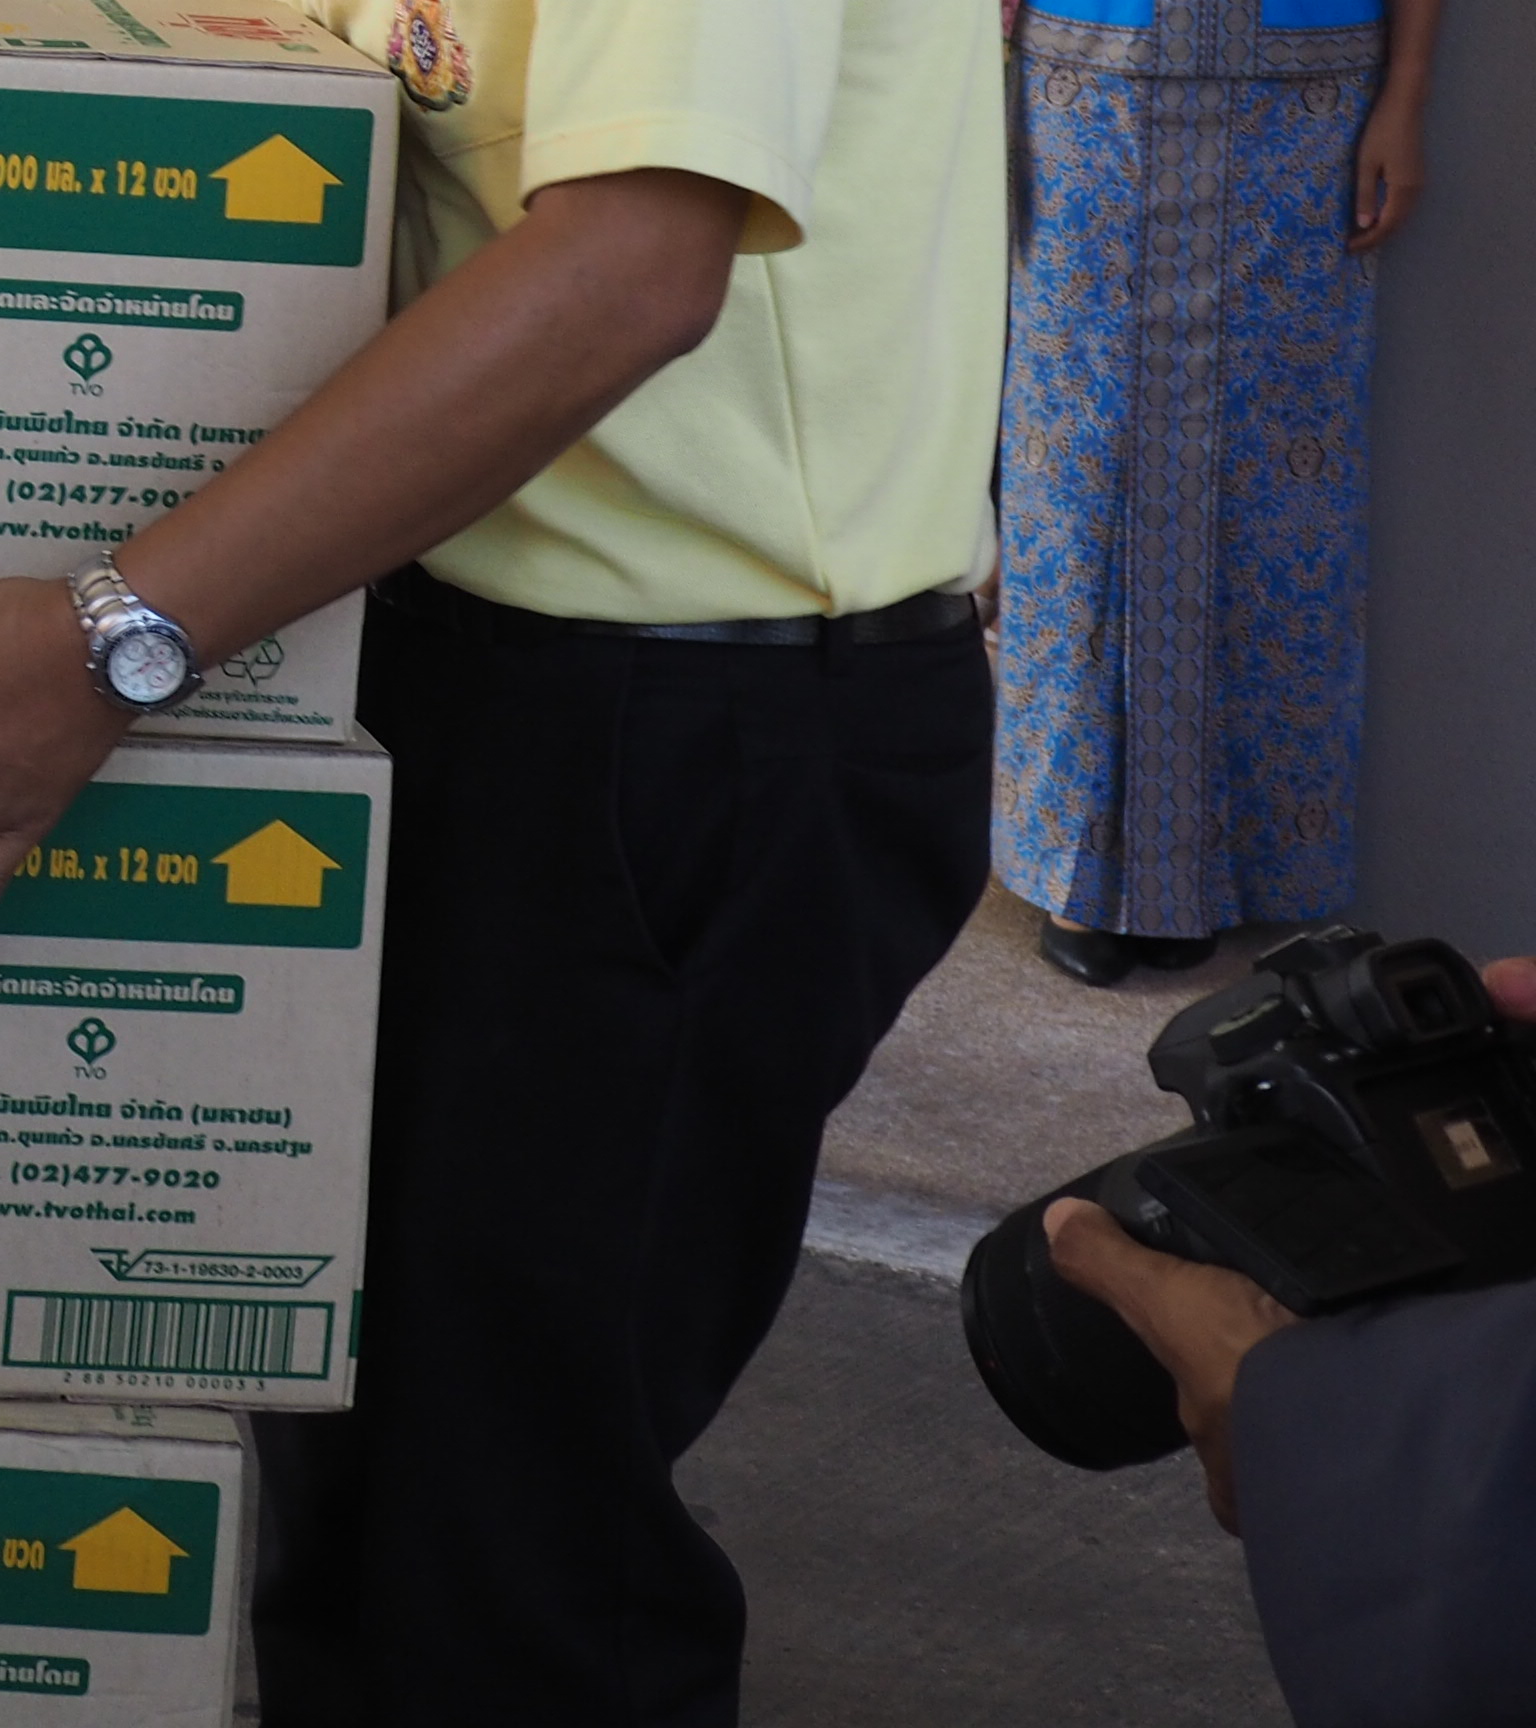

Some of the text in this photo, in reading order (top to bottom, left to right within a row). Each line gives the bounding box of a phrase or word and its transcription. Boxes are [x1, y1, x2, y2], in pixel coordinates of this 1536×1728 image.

[45, 159, 82, 194] มล.
[90, 166, 106, 196] x
[116, 160, 146, 198] 12
[154, 165, 198, 201] ขวด
[118, 416, 182, 443] จำกัด
[51, 850, 198, 885] มล. 12 ขวด
[120, 1099, 183, 1121] จำกัด
[191, 1103, 293, 1128] (มหาชน)
[10, 1159, 221, 1190] (02)477-9020
[3, 1537, 45, 1571] ขวด
